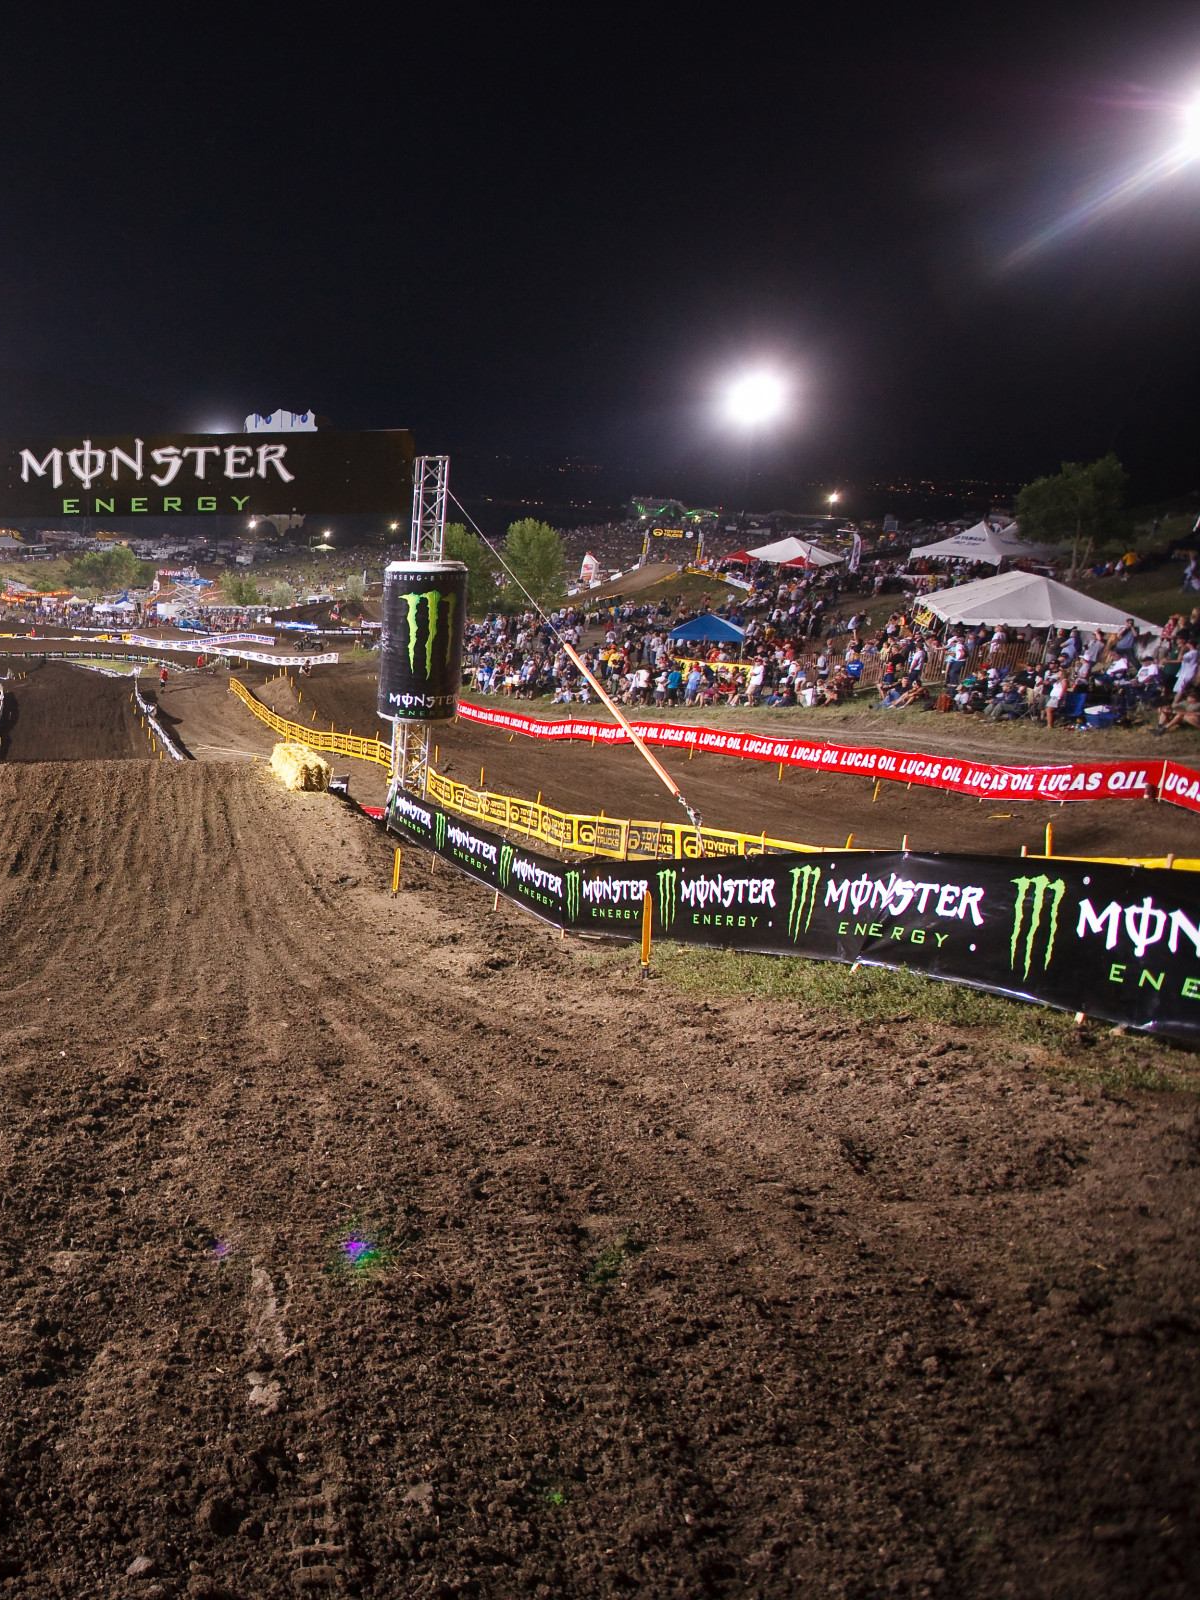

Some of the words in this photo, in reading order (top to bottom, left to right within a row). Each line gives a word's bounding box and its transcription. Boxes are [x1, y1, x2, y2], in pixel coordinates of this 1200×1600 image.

[20, 438, 295, 490] MONSTER
[63, 495, 250, 514] ENERGY
[961, 535, 987, 543] YAMAHA
[573, 724, 589, 736] LUCAS
[589, 726, 597, 736] OIL
[647, 727, 658, 738] OIL
[660, 728, 684, 742] LUCAS
[685, 731, 697, 743] OIL
[699, 732, 726, 747] LUCAS
[727, 736, 741, 750] OIL
[743, 740, 772, 755] LUCAS
[774, 744, 790, 758] OIL
[791, 745, 821, 763] LUCAS
[822, 750, 838, 764] OIL
[840, 752, 876, 768] LUCAS
[877, 755, 897, 771] OIL
[899, 759, 941, 779] LUCAS
[941, 765, 963, 783] OIL
[963, 769, 1008, 791] LUCAS
[1010, 774, 1035, 791] OIL
[1038, 773, 1103, 792] LUCAS
[1107, 771, 1149, 790] OIL
[464, 798, 478, 809] TRUCKS
[490, 806, 506, 818] TRUCKS
[447, 824, 498, 864] MONSTER
[597, 837, 619, 848] TRUCKS
[598, 828, 620, 837] TOYOTA
[703, 839, 737, 855] TOYOTA
[453, 848, 488, 872] ENERGY
[512, 857, 563, 898] MONSTER
[582, 875, 648, 904] MONSTER
[518, 884, 554, 908] ENERGY
[680, 874, 776, 908] MONSTER
[824, 872, 985, 927] MONSTER
[592, 908, 639, 920] ENERGY
[693, 913, 758, 928] ENERGY
[838, 921, 949, 948] ENERGY
